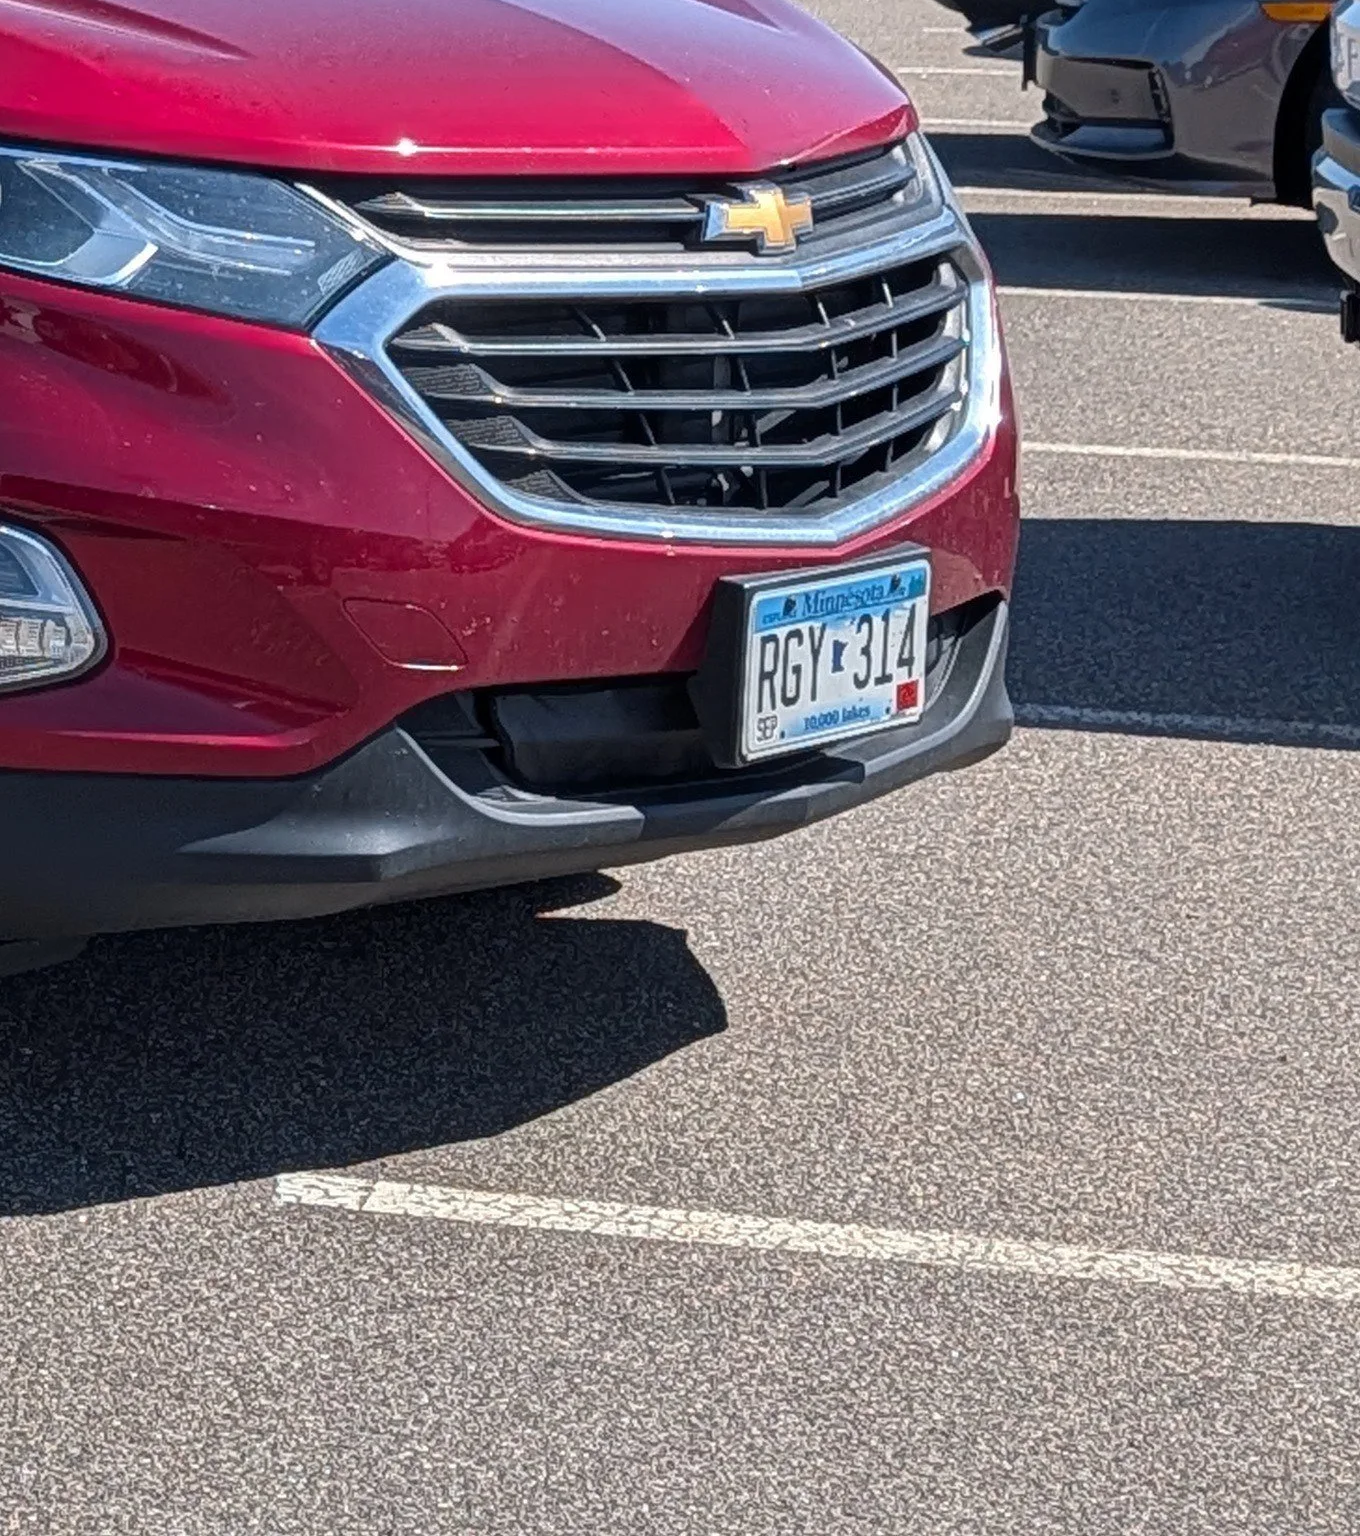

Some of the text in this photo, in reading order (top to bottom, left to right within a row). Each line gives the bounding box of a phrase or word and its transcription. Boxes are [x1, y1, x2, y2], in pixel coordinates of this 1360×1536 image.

[802, 583, 885, 618] Minnesota
[756, 602, 918, 714] RGY 314
